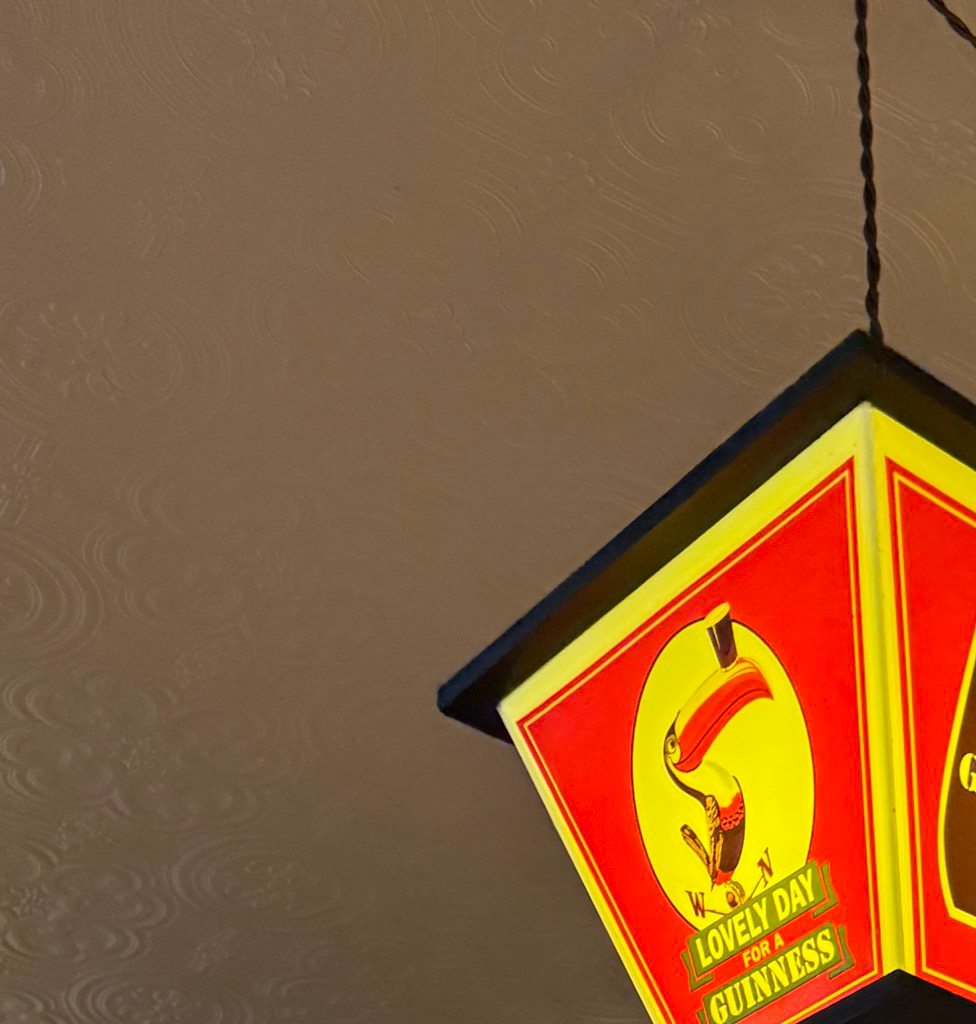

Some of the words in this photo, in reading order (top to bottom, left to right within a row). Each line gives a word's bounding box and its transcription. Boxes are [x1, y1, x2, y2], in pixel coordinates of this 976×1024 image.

[757, 847, 774, 886] N
[685, 891, 705, 918] W
[696, 897, 769, 968] LOVELY
[772, 868, 816, 921] DAY
[742, 939, 771, 968] FOR
[774, 932, 785, 950] A
[710, 928, 835, 1024] GUINNESS
